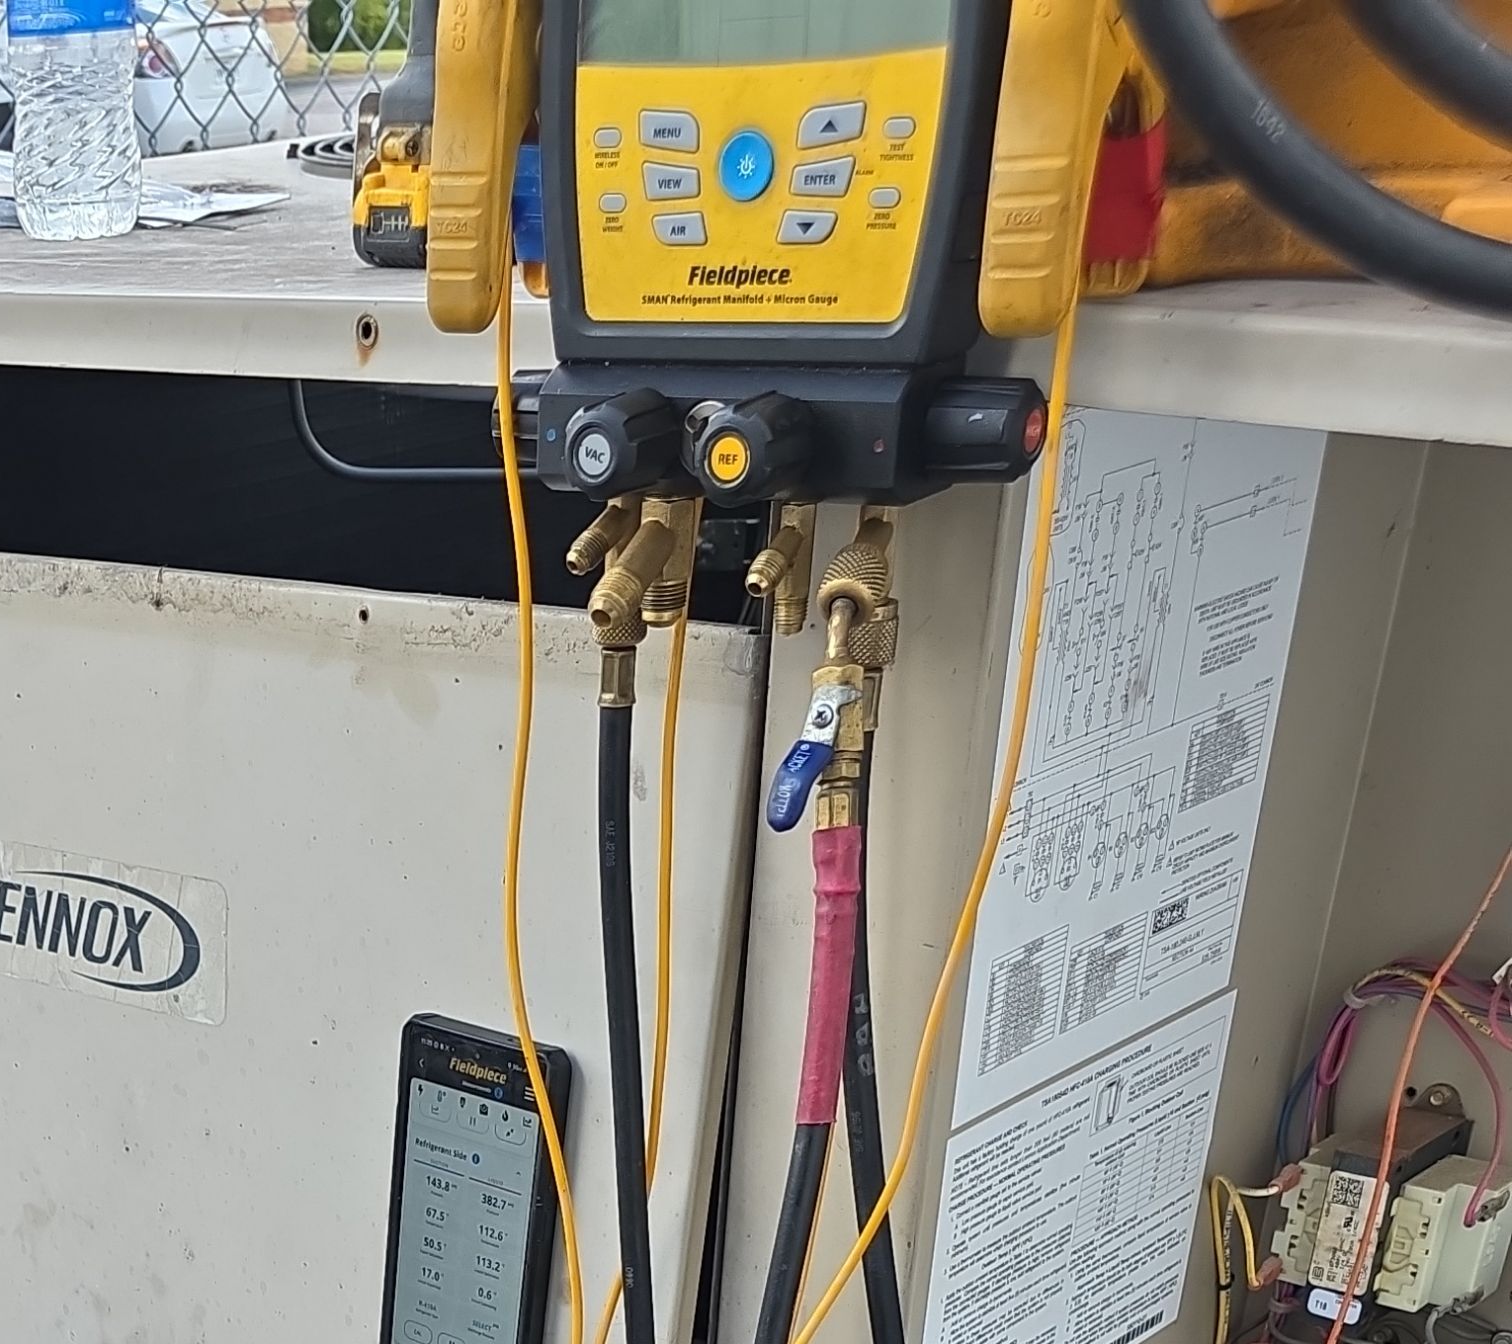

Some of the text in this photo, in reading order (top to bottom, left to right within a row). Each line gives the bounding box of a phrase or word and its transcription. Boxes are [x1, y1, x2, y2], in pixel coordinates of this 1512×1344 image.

[653, 127, 681, 138] MENU
[889, 143, 904, 151] TEST
[879, 153, 913, 161] TIGHTNESS
[657, 177, 681, 188] VIEW
[804, 174, 835, 186] ENTER
[873, 212, 890, 220] ZERO
[670, 225, 685, 236] AIR
[866, 221, 896, 229] PRESSURE
[687, 265, 791, 289] Fieldpiece
[670, 294, 720, 305] Refrigerant
[723, 294, 763, 304] Manifold
[773, 294, 805, 304] Micron
[808, 294, 838, 305] Gauge
[583, 445, 606, 465] VAC
[718, 452, 739, 465] REF
[449, 1057, 507, 1085] Fieldpiece
[426, 1175, 450, 1192] 143.8
[481, 1193, 507, 1211] 382.7
[479, 1224, 504, 1242] 112.6
[476, 1255, 501, 1273] 113.2
